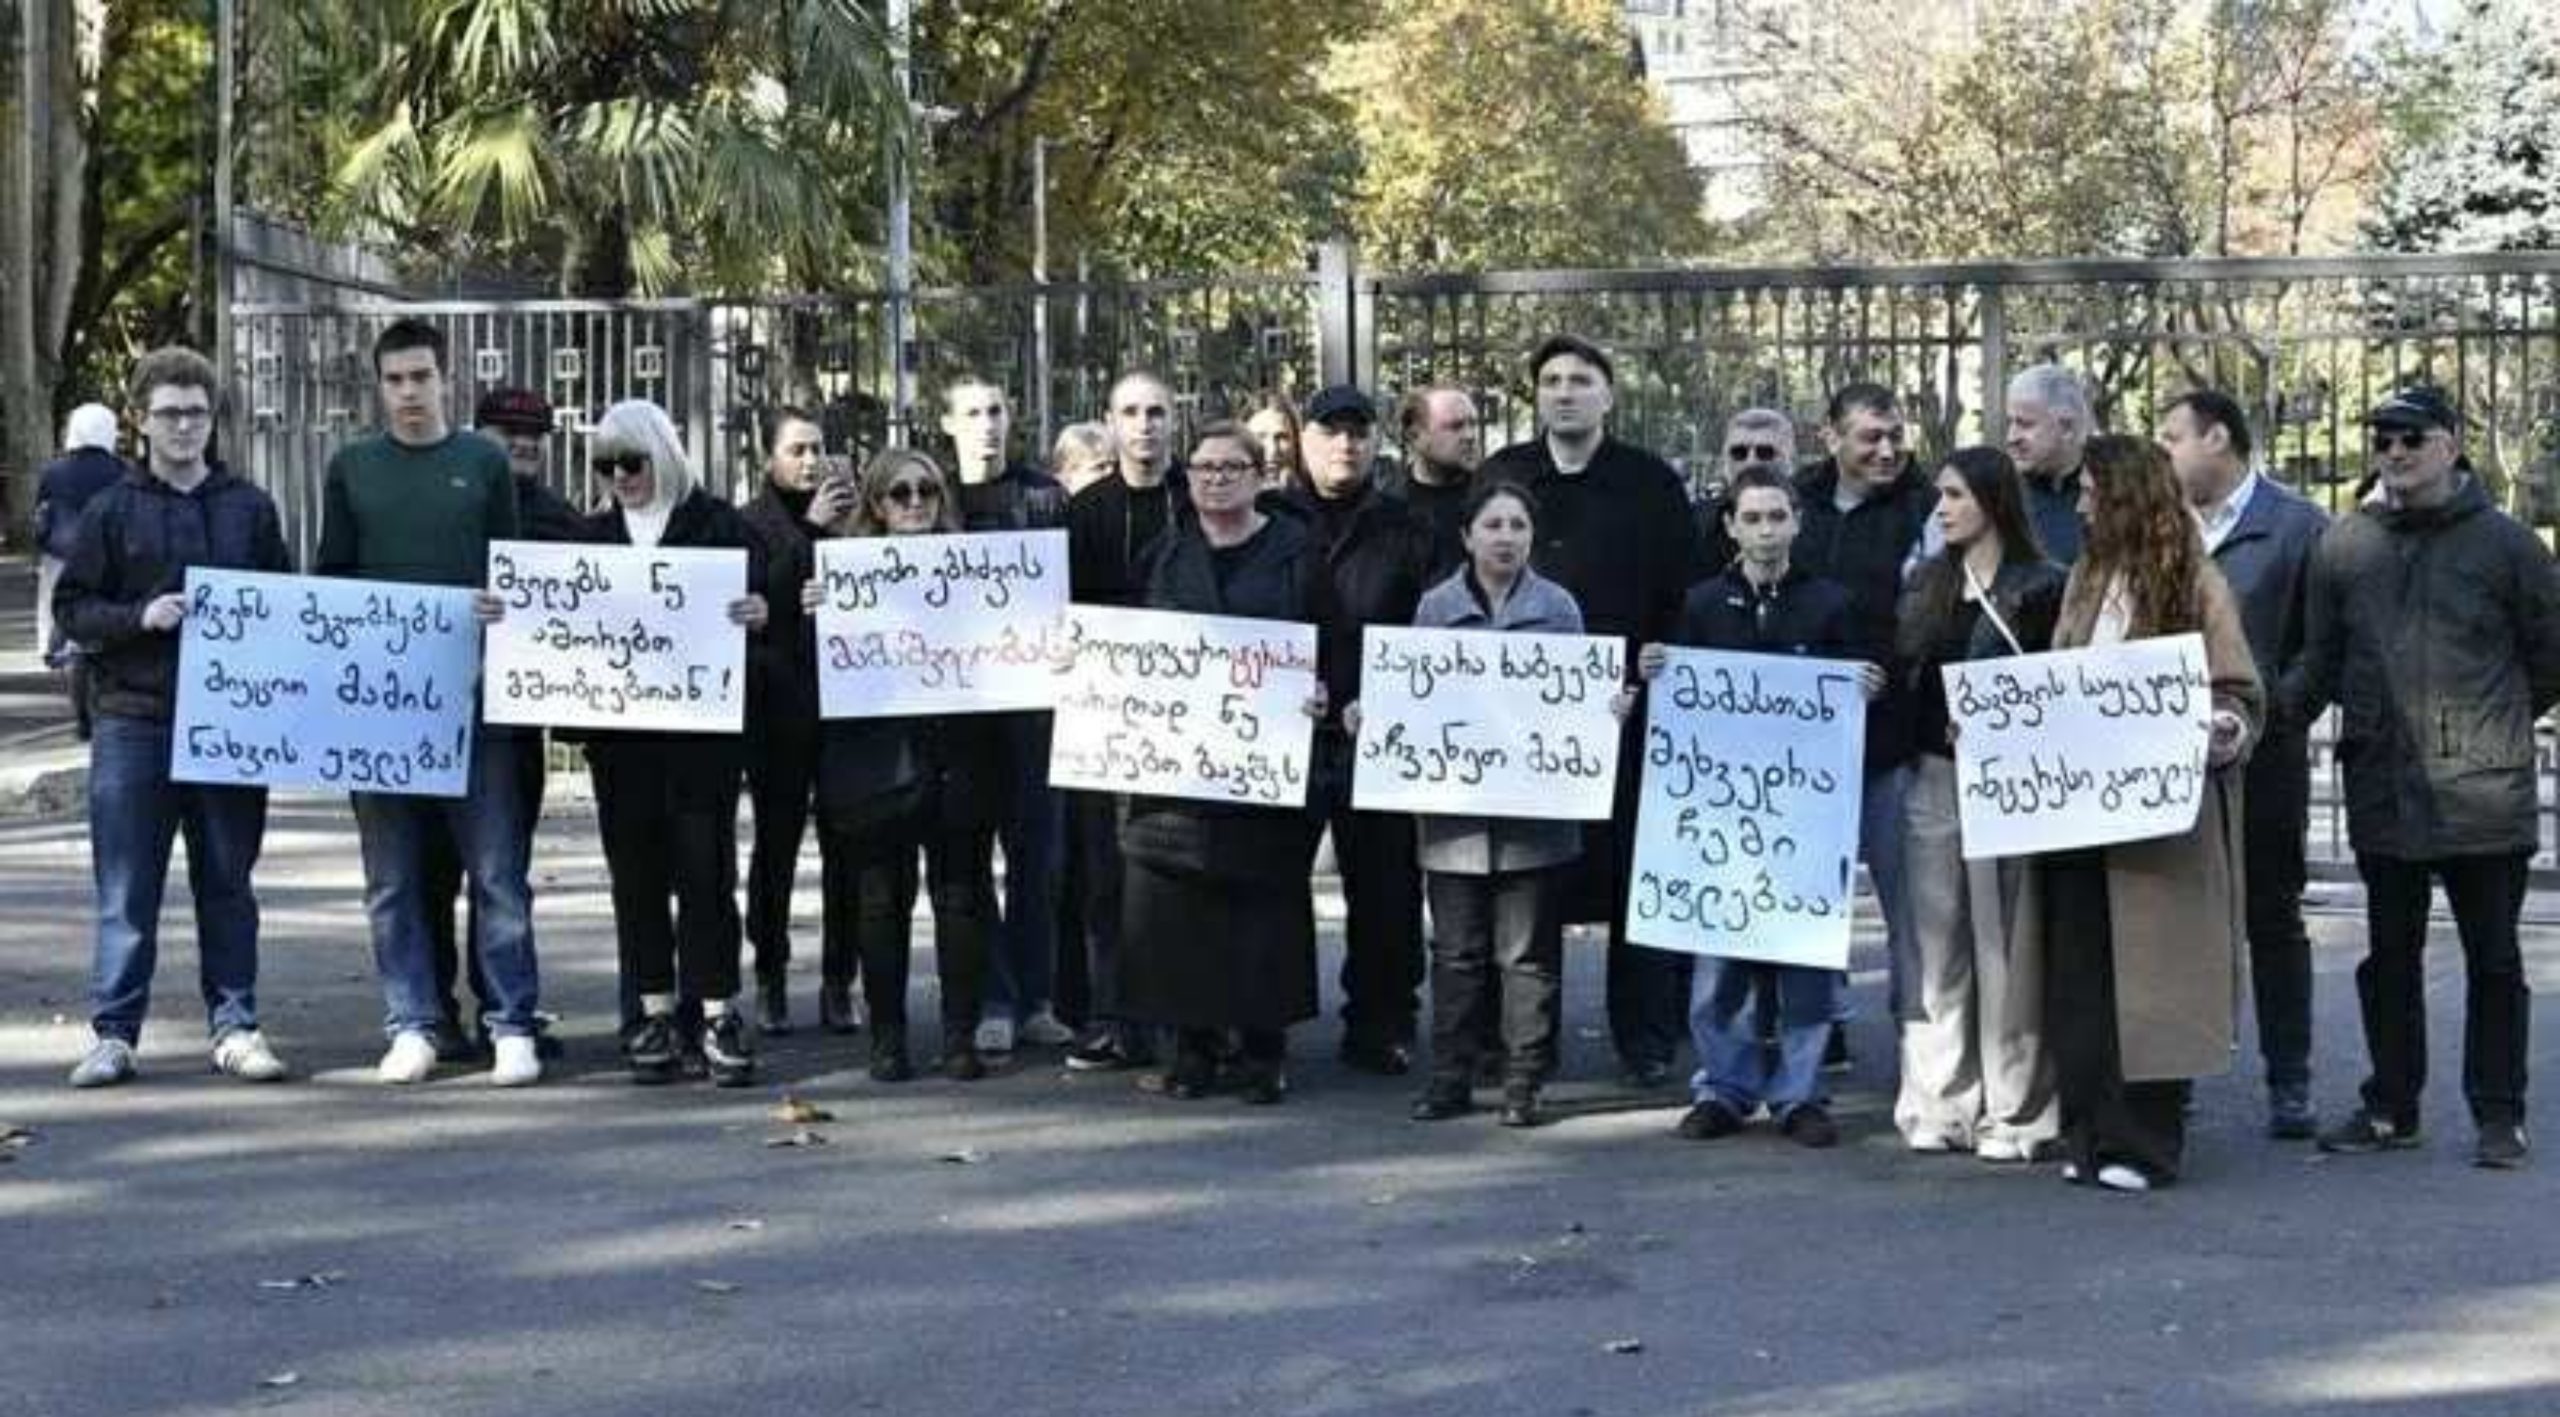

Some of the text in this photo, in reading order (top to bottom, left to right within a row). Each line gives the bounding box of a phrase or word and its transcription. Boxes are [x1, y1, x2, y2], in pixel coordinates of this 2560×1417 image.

[494, 553, 686, 612] შვილებს ნუ
[822, 541, 1044, 612] რეჟიმი ებრძვის
[192, 583, 452, 656] ჩვენს მეგობრებს
[532, 616, 673, 669] აშორებთ
[204, 659, 442, 711] მიეცით მამის
[1373, 639, 1486, 699] პატარა
[1672, 664, 1854, 721] მამასთან
[1958, 669, 2066, 731] ბავშვის
[1220, 693, 1259, 742] ნუ
[187, 725, 465, 787] ნახვის უფლება!
[1362, 721, 1602, 785] აჩვენეთ მამა
[1649, 725, 1837, 819] შეხვედრა
[1966, 753, 2094, 815] ინტერესი
[1676, 806, 1797, 866] ჩემი
[1638, 855, 1849, 931] უფლებაა!
